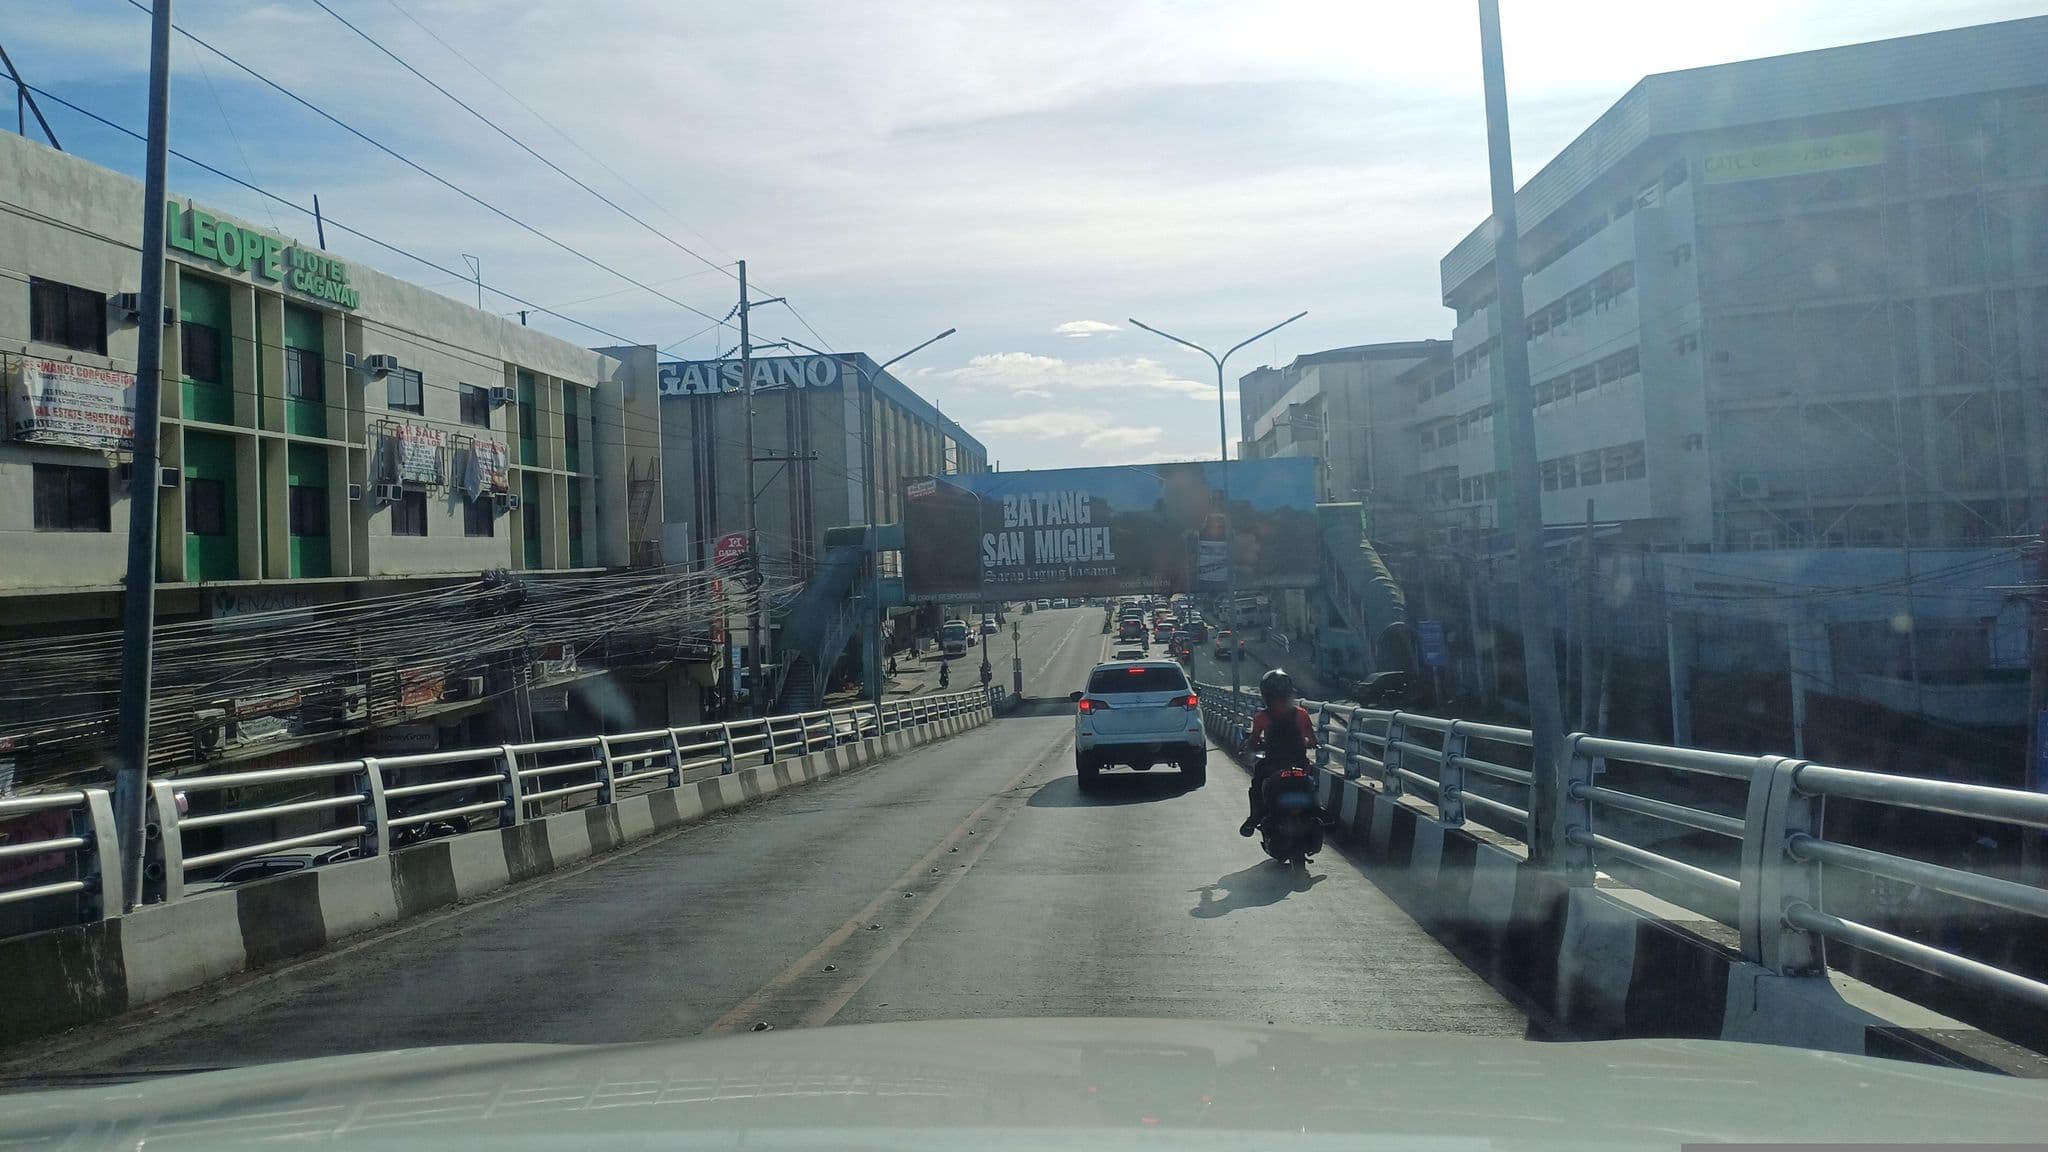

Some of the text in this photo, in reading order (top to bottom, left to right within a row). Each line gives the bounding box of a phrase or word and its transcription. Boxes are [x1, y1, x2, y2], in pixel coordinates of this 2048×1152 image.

[167, 200, 285, 282] LEOPE
[289, 247, 350, 286] HOTEL
[292, 268, 361, 310] CAGAYAN
[659, 356, 837, 396] GAISANO
[53, 407, 82, 420] ESTATE
[84, 410, 131, 426] MORTGAGE
[415, 426, 442, 440] SALE
[1003, 490, 1091, 528] BATANG
[982, 526, 1115, 567] SAN MIGUEL
